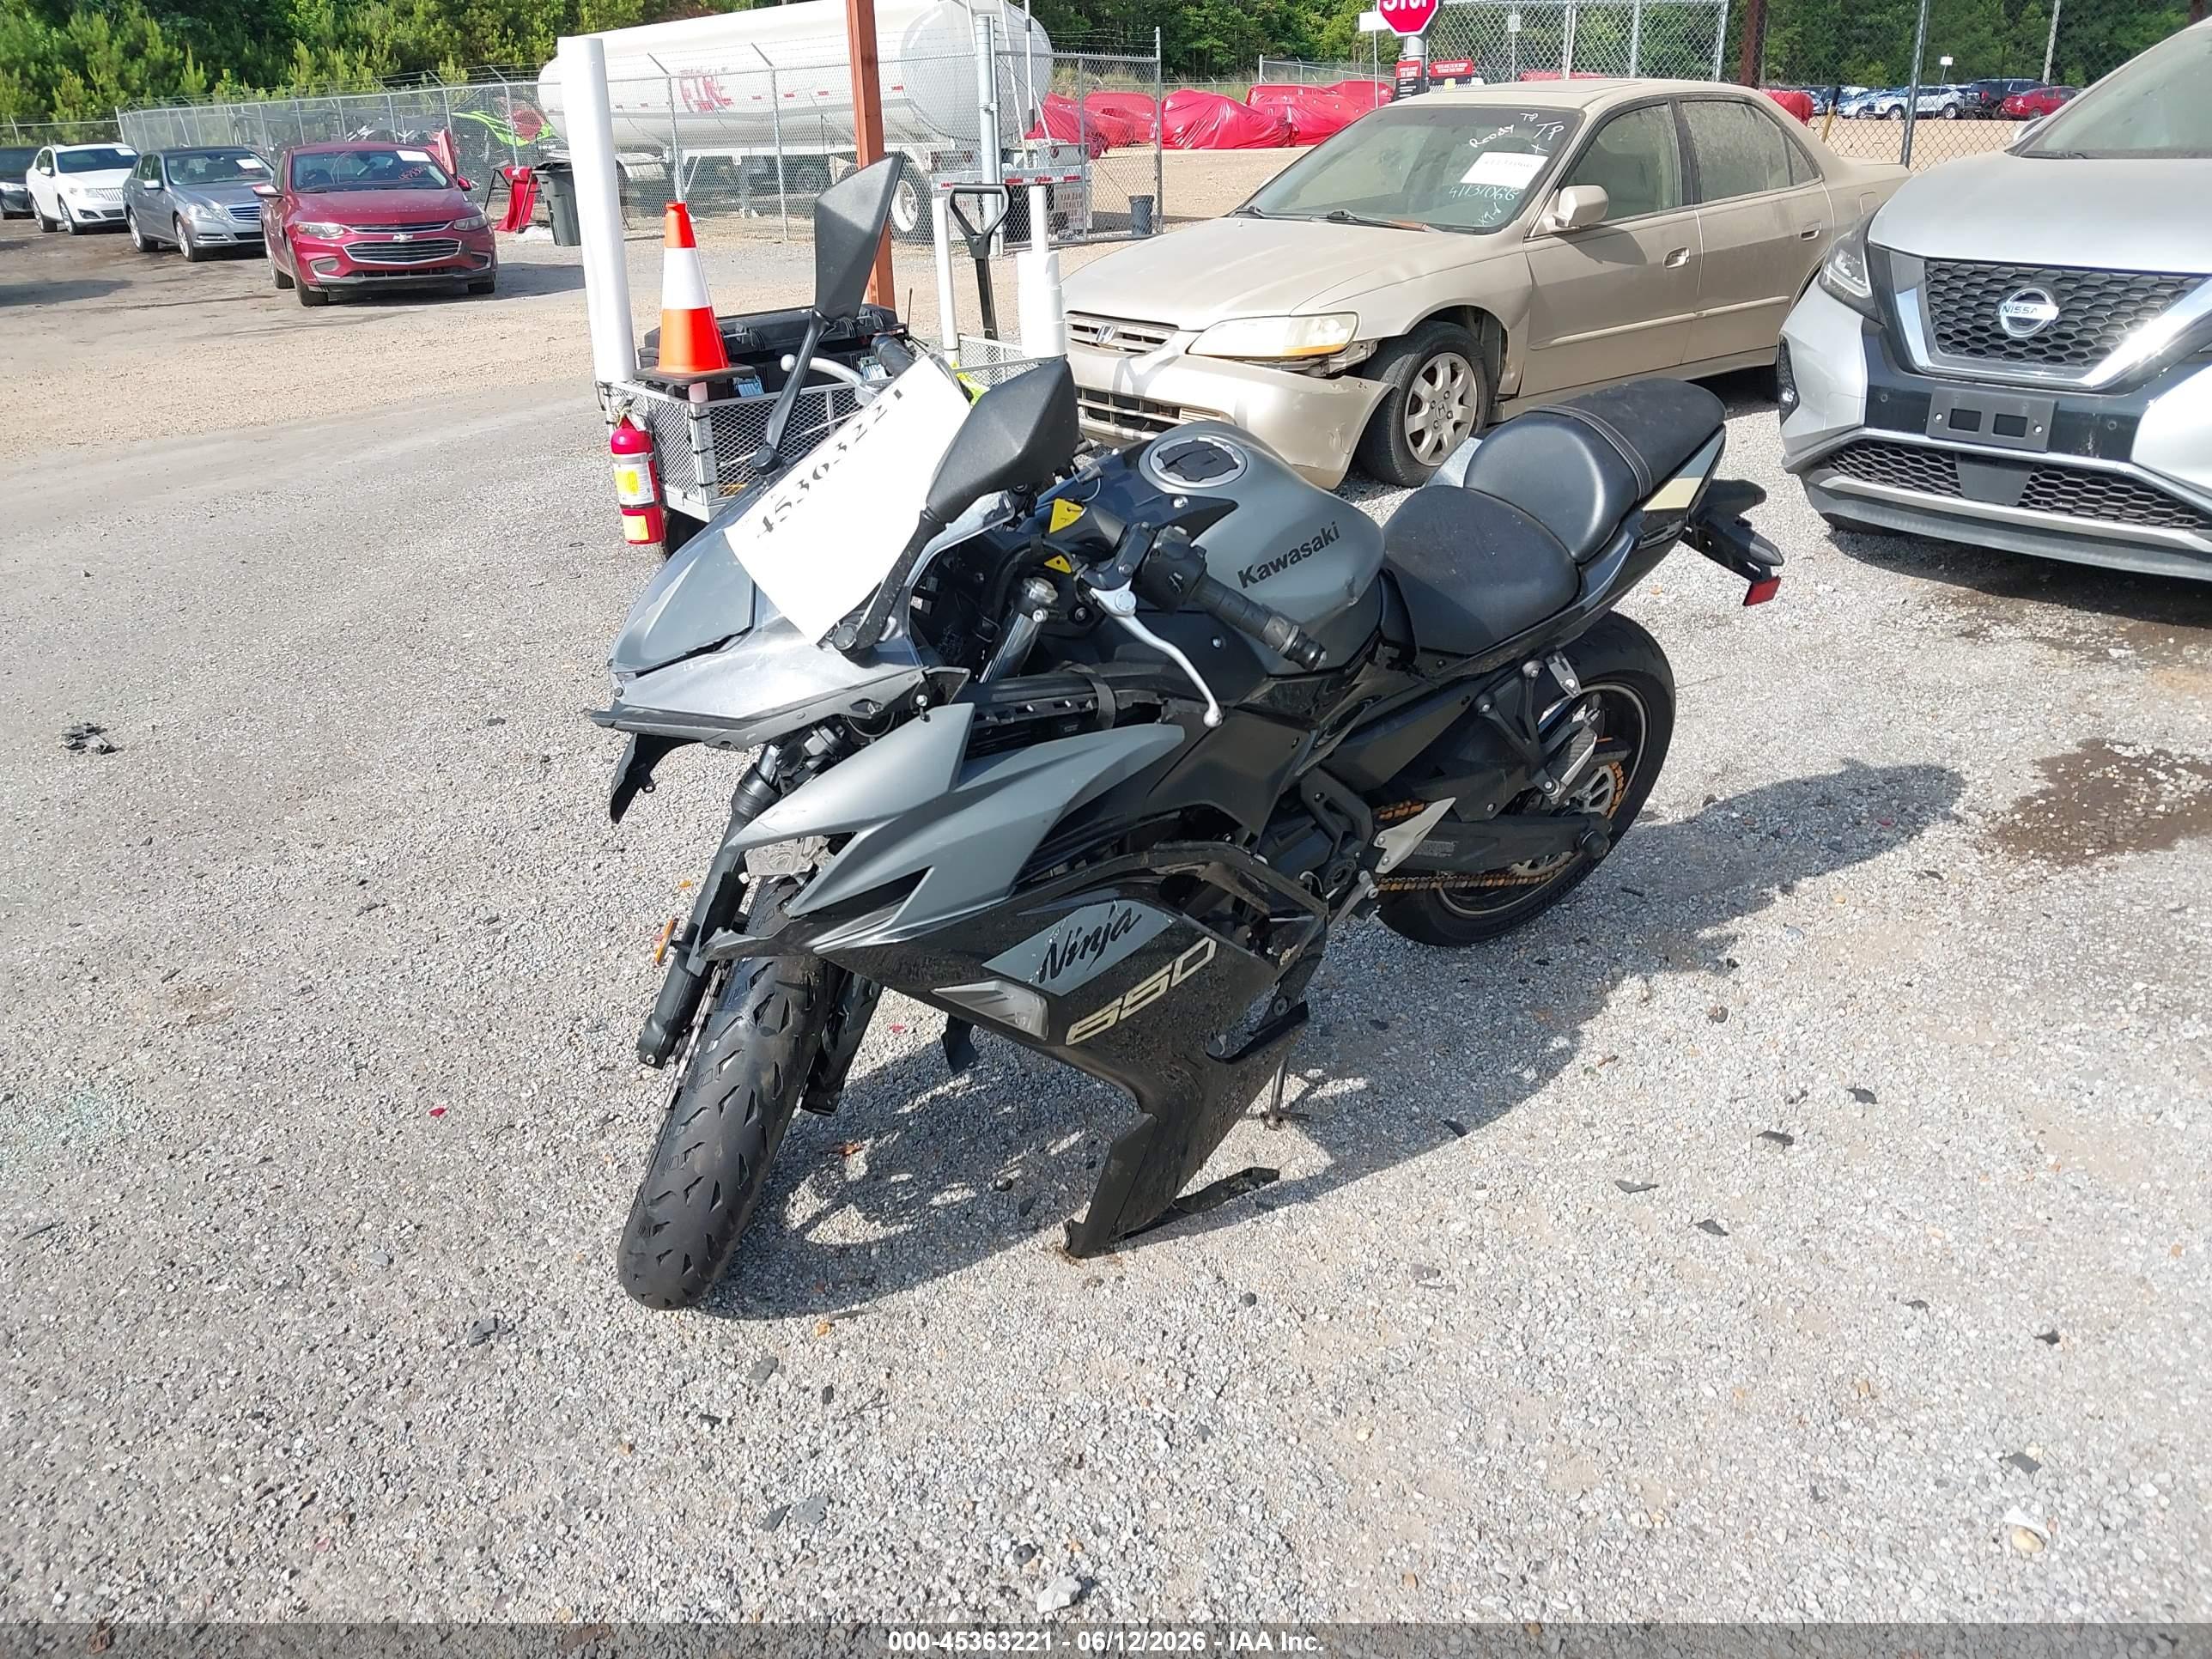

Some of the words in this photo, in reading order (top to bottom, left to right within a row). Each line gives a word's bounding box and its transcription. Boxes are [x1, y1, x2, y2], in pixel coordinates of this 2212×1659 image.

[1237, 520, 1340, 589] Kawasaki
[1038, 904, 1143, 984] Ninja
[1066, 936, 1217, 1046] 650
